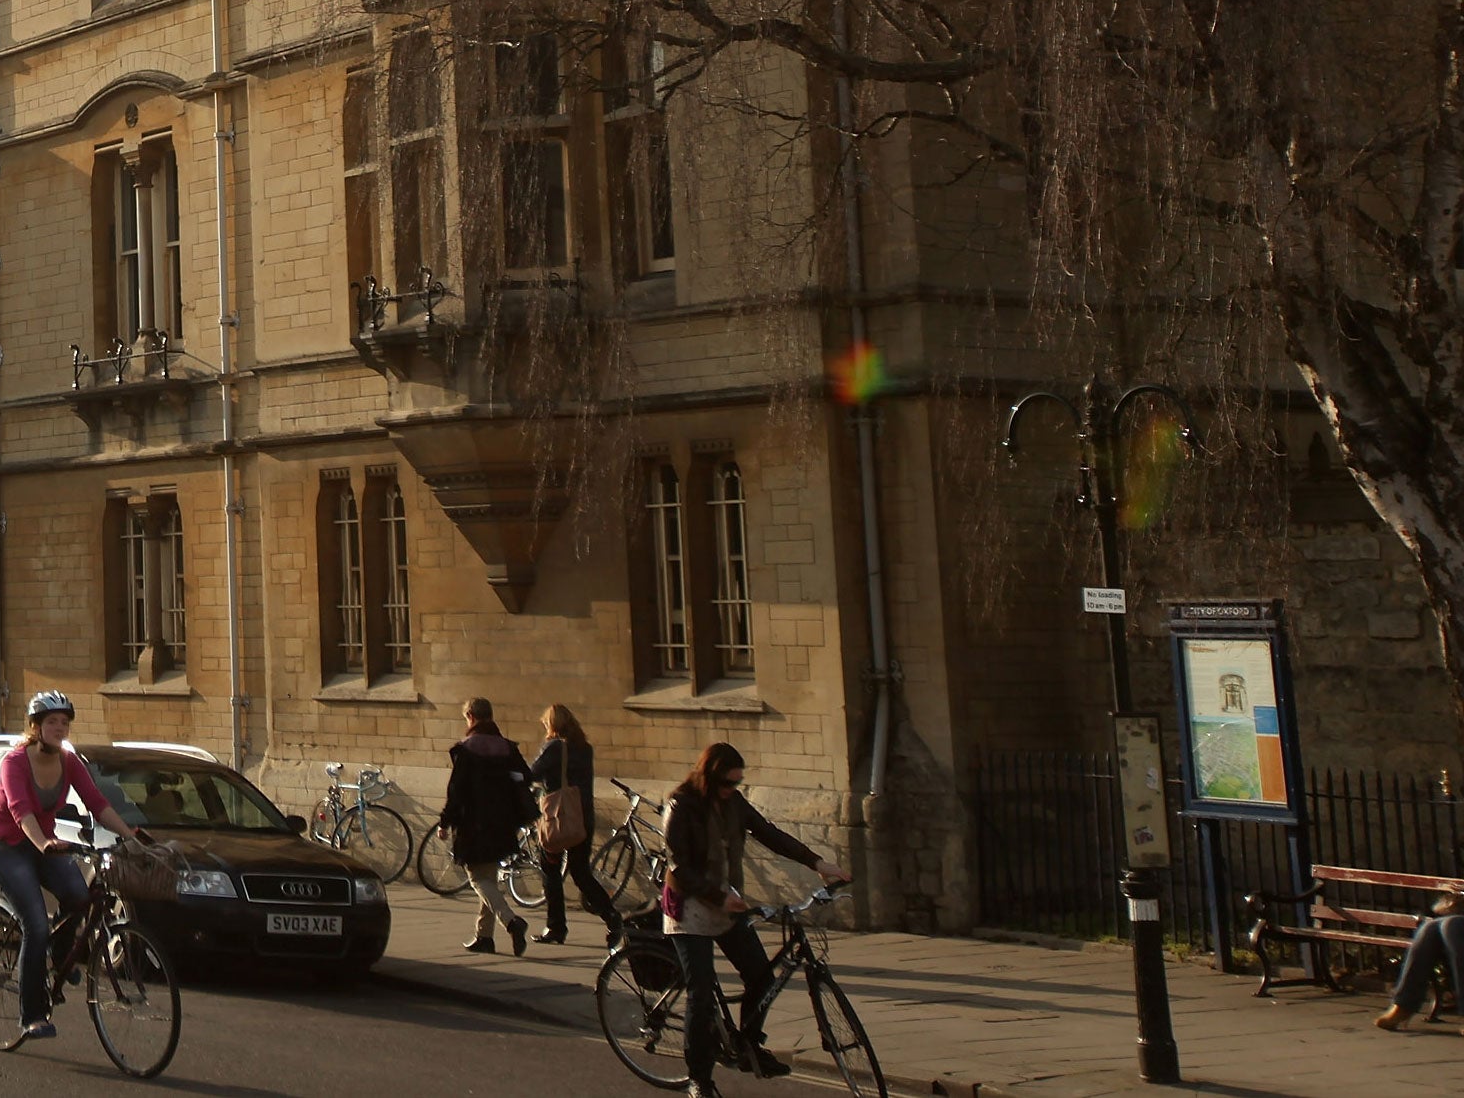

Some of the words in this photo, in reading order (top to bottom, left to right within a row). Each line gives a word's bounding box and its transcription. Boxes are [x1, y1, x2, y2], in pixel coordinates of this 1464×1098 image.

[1098, 592, 1122, 600] loading
[1206, 607, 1216, 615] OF
[1217, 607, 1250, 616] OXFORD
[273, 916, 309, 931] SV03
[312, 917, 338, 933] XAE
